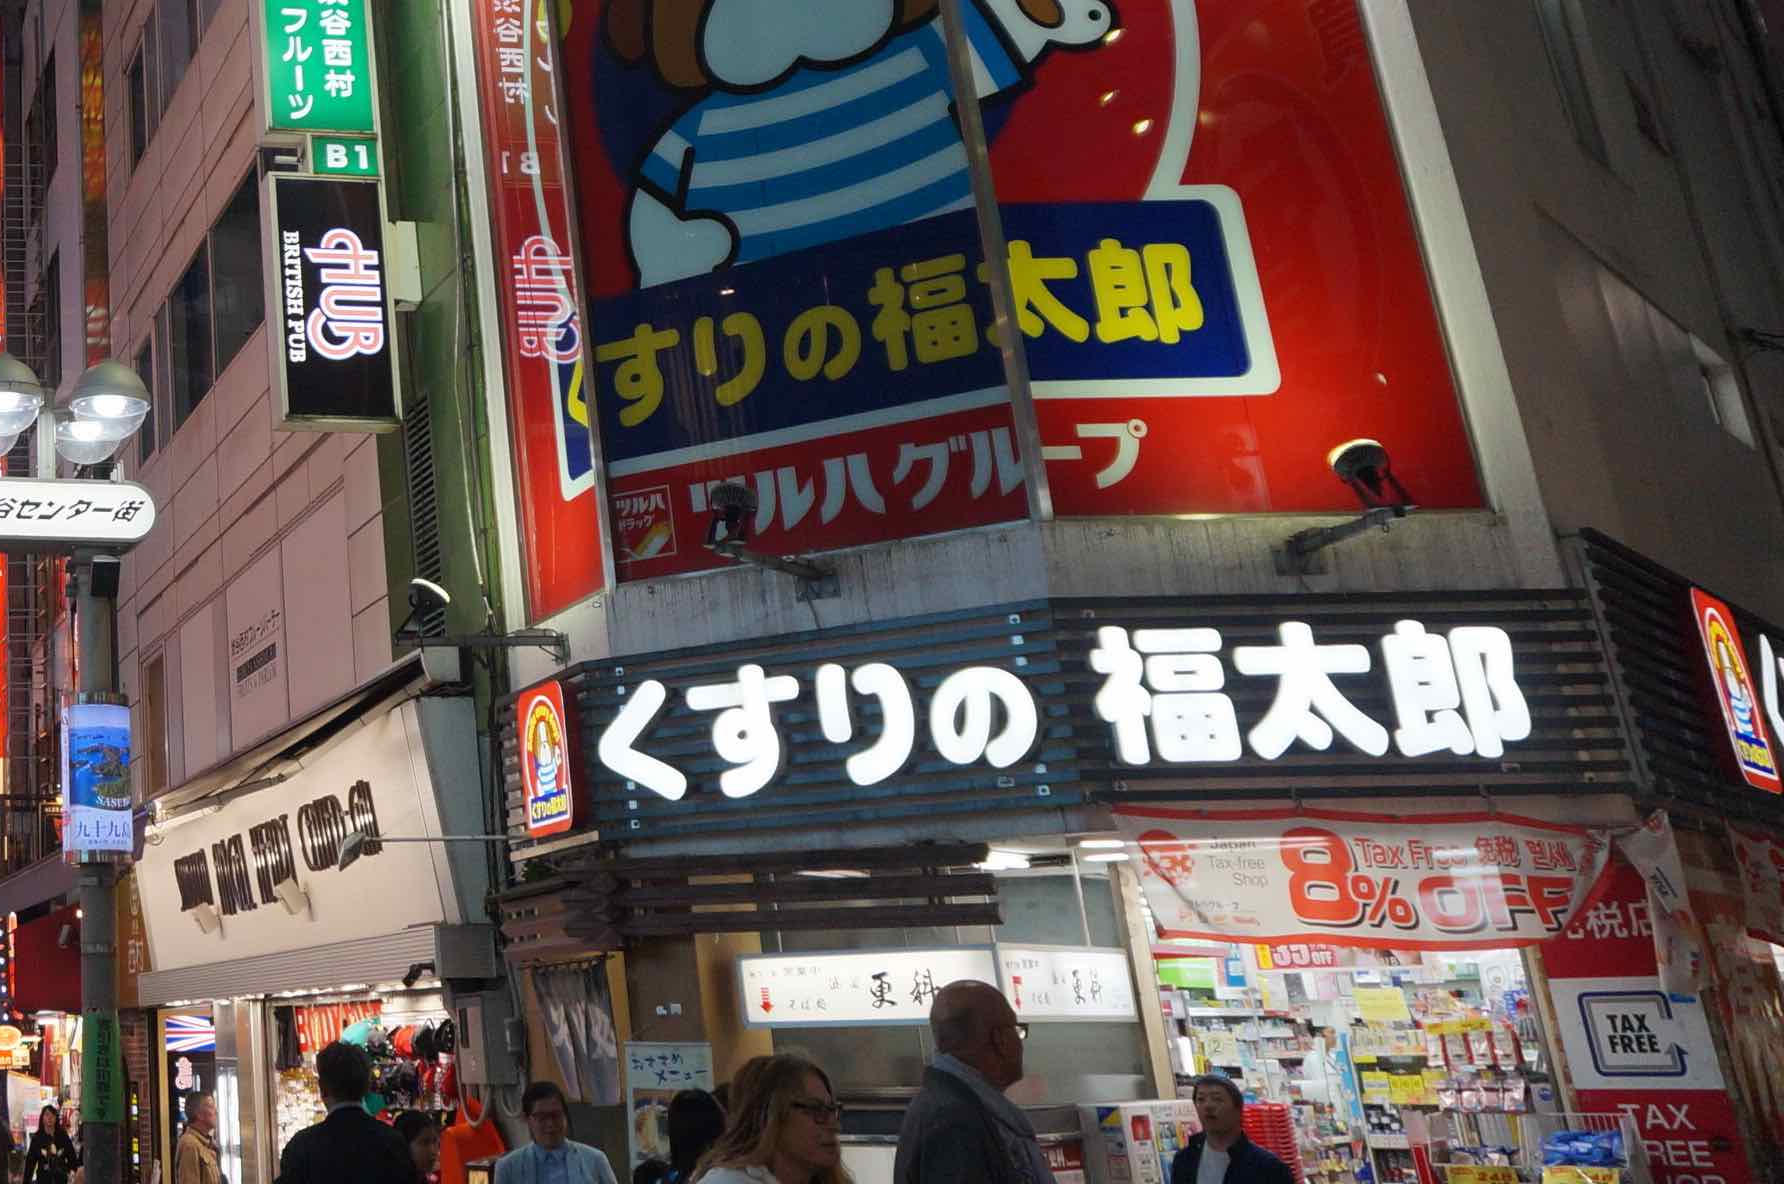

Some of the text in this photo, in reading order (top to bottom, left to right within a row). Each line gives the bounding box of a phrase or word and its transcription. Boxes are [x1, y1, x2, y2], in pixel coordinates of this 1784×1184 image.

[280, 7, 314, 120] フルーツ
[325, 143, 368, 171] B1
[282, 230, 308, 363] BRITISH PUB
[304, 227, 385, 362] HUB
[598, 619, 1532, 801] くすりの福太郎
[1207, 855, 1266, 870] Tax-free
[1353, 837, 1405, 870] Tax
[1406, 839, 1468, 871] Free
[1231, 872, 1268, 889] Shop
[1279, 826, 1575, 935] 8% OFF
[1568, 899, 1655, 941] 税店
[1605, 1014, 1651, 1034] TAX
[1607, 1033, 1661, 1054] FREE
[1617, 1103, 1697, 1131] TAX
[1640, 1139, 1716, 1167] REE
